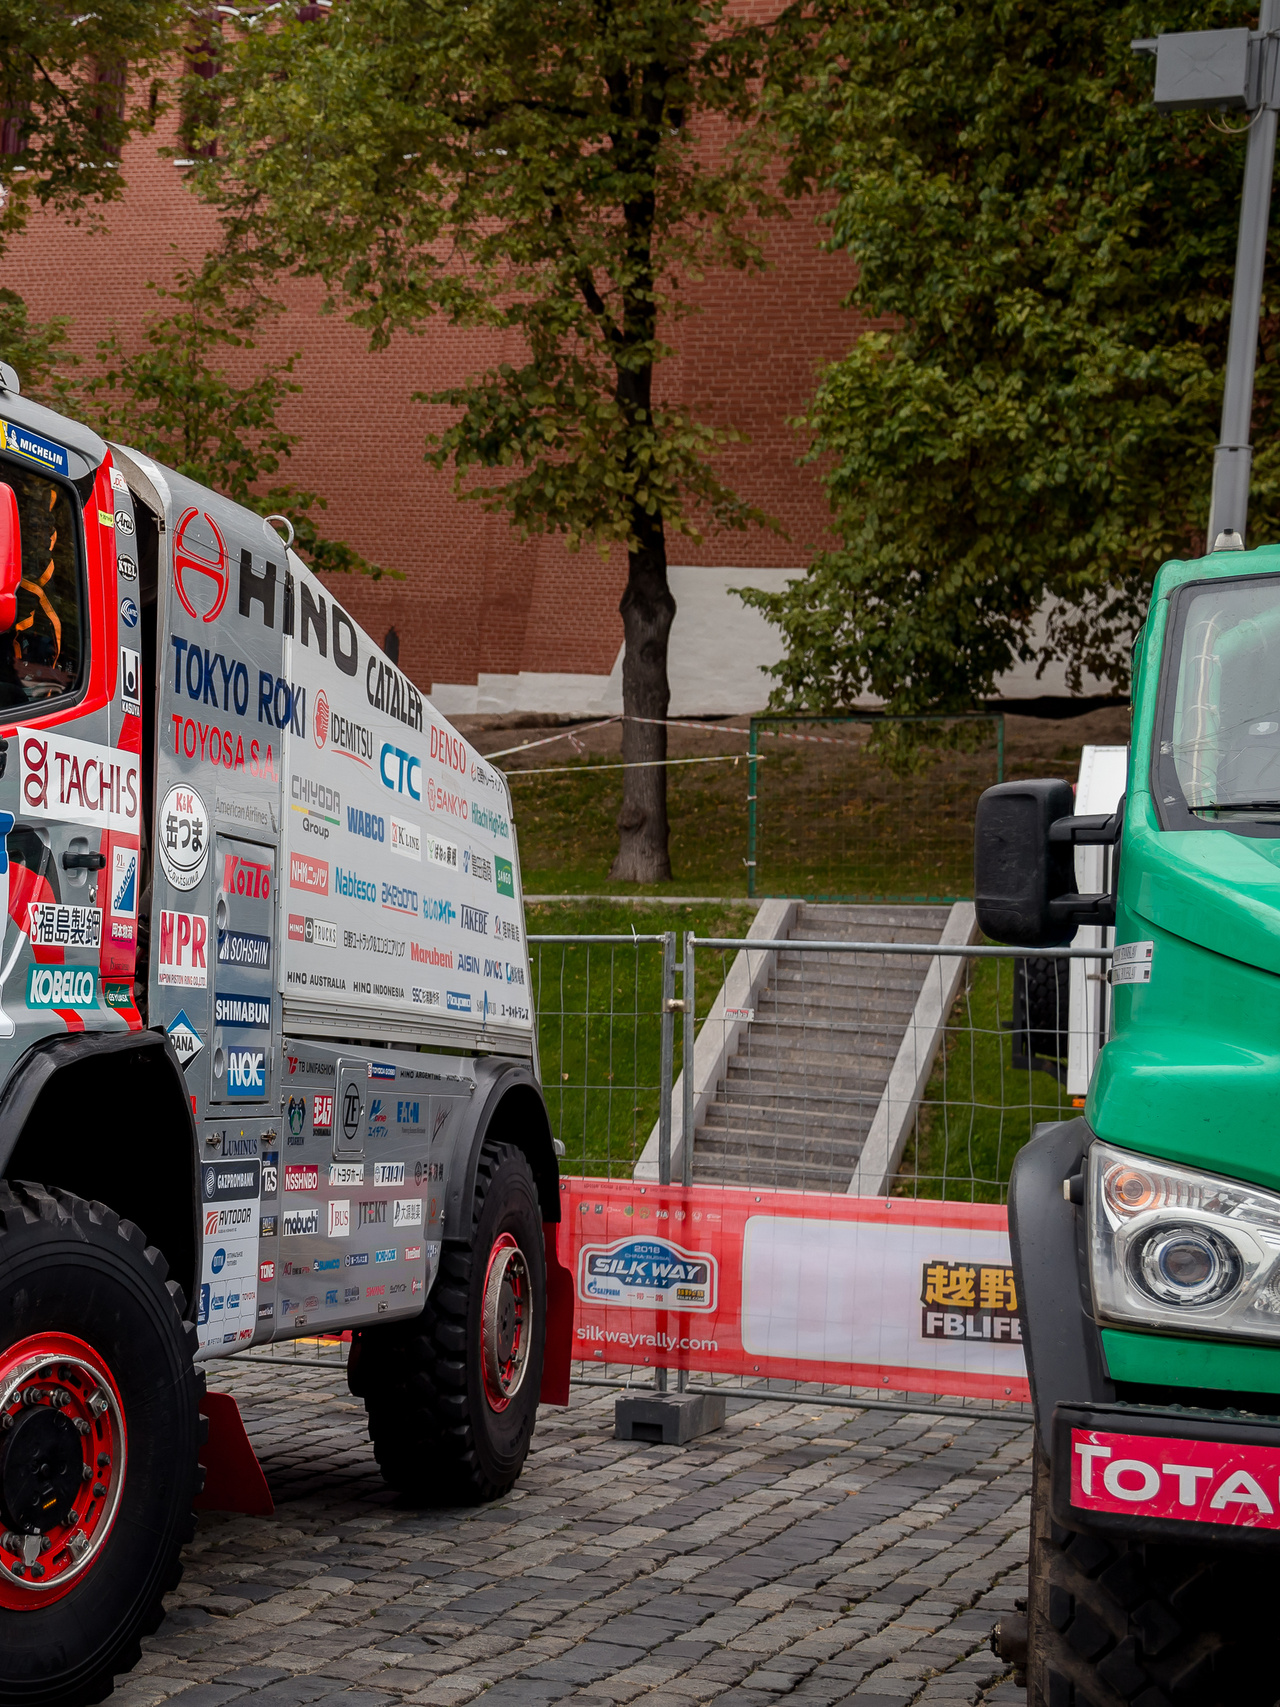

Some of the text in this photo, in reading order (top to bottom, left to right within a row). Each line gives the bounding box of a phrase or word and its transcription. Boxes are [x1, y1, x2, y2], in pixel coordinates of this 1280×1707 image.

[20, 438, 63, 466] MICHELIN
[239, 548, 358, 677] HINO
[172, 634, 307, 739] TOKYO ROKI
[366, 656, 423, 733] CATALER
[172, 714, 279, 783] TOYOSA S.A.
[331, 712, 373, 760] IDEMITSU
[430, 724, 467, 774] DENSO
[54, 751, 138, 819] TACHI-S
[380, 743, 422, 802] CTC
[292, 774, 341, 815] CHIYODA
[437, 787, 468, 820] SANKYO
[215, 797, 268, 826] American Airlines
[347, 806, 385, 843] WABCO
[166, 811, 203, 853] 缶つま
[302, 817, 330, 840] Group
[405, 834, 420, 851] LINE
[114, 856, 136, 910] OKAMOTO
[335, 867, 377, 903] Nabtesco
[38, 905, 101, 946] 福島製鋼
[289, 923, 336, 943] HINO TRUCKS
[461, 904, 489, 935] TAKEBE
[160, 912, 207, 968] NPR
[230, 937, 268, 965] SOHSHIN
[410, 941, 454, 969] Marubeni
[458, 953, 480, 975] AISIN
[30, 969, 94, 1005] KOBELCO
[287, 971, 346, 990] HINO AUSTRALIA
[353, 981, 405, 998] HINO INDONESIA
[215, 999, 270, 1024] SHIMABUN
[230, 1051, 263, 1088] NOK
[221, 1130, 258, 1157] LUMINUS
[217, 1172, 255, 1189] GAZPROMBANK
[219, 1207, 252, 1226] AVTODOR
[284, 1210, 319, 1236] mabuchi
[357, 1201, 388, 1230] JTEKT
[634, 1245, 661, 1254] 2018
[260, 1265, 274, 1279] TONE
[593, 1258, 702, 1280] SILK WAY
[625, 1276, 669, 1286] RALLY
[596, 1286, 620, 1296] GAZPROM
[576, 1325, 718, 1351] silkwayrally.com
[1074, 1442, 1280, 1514] TOTA
